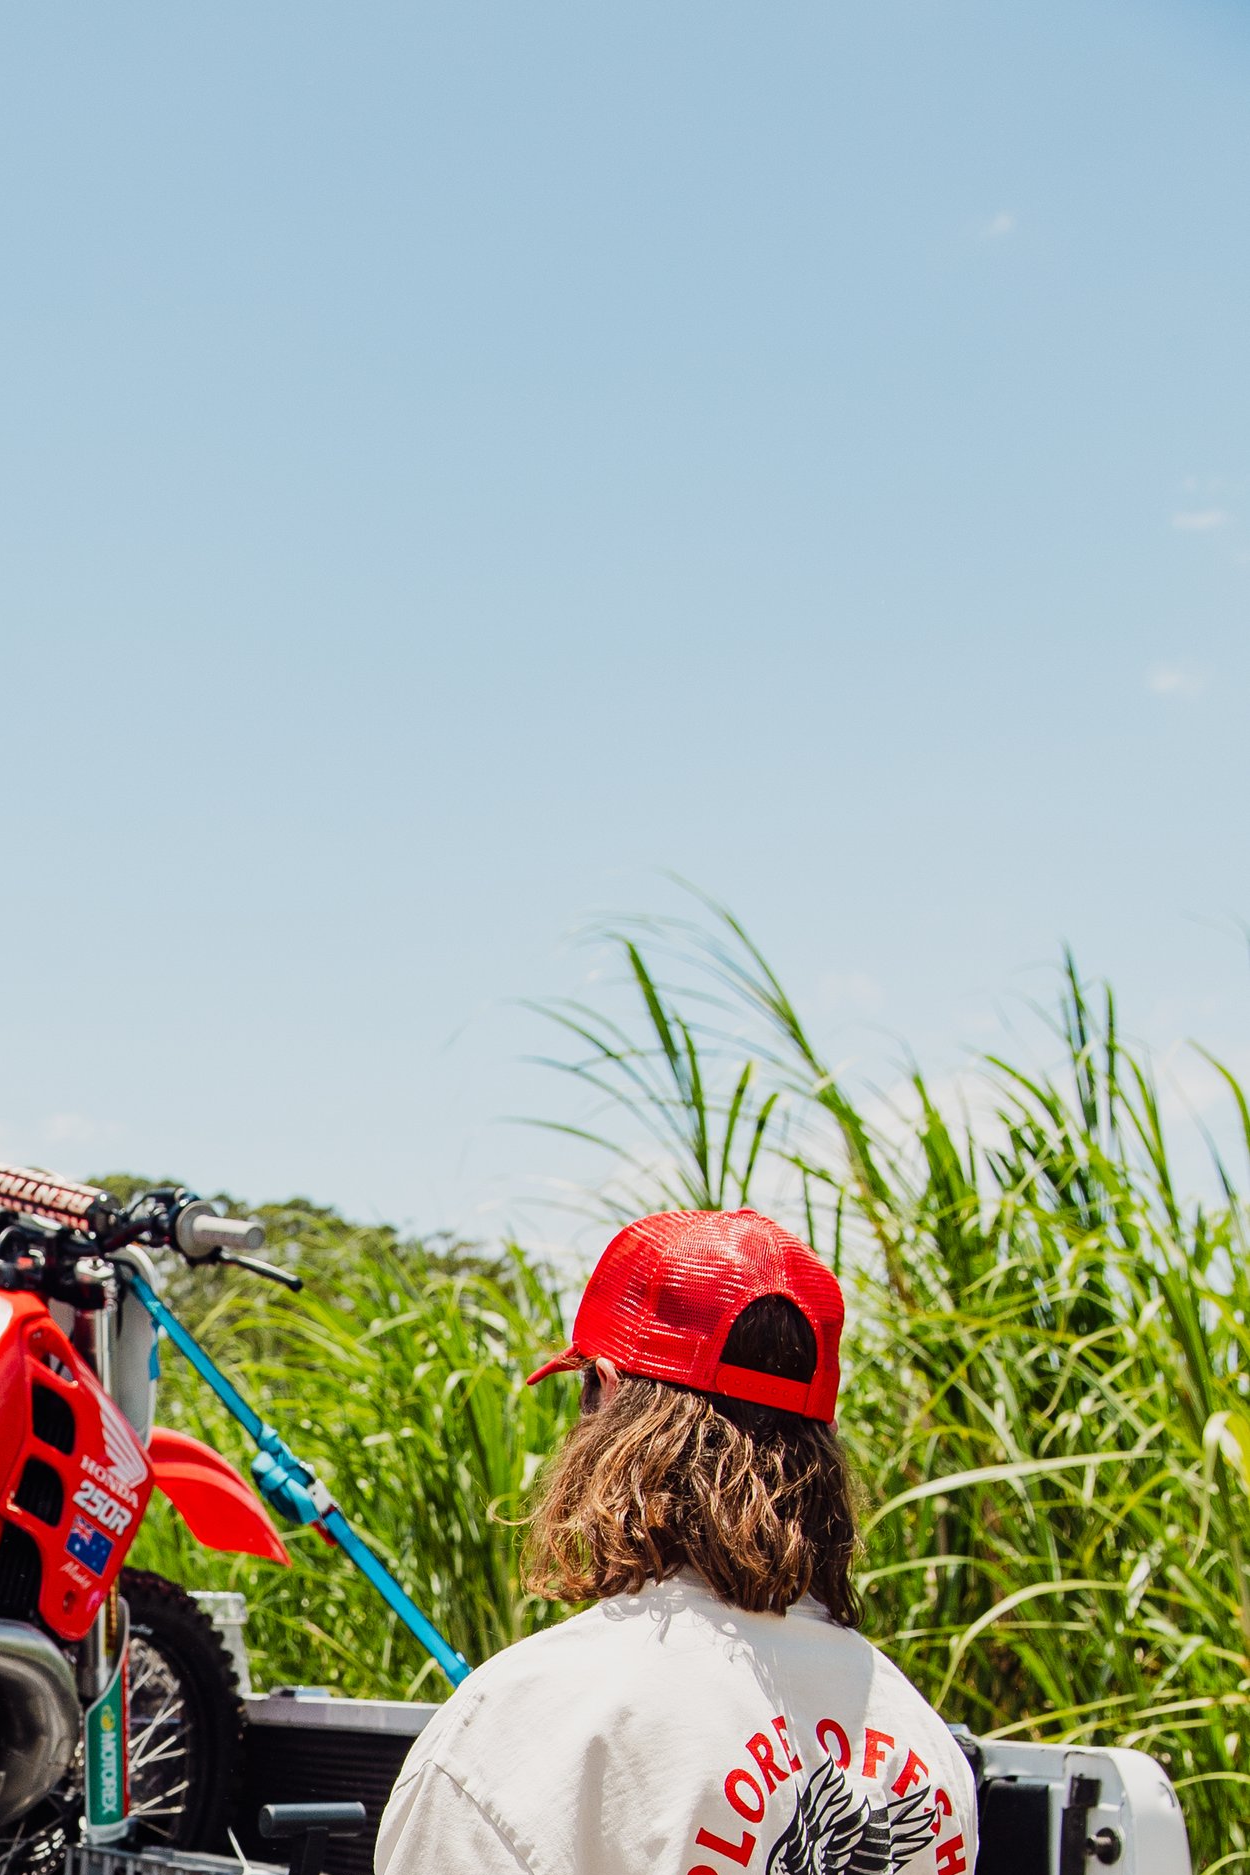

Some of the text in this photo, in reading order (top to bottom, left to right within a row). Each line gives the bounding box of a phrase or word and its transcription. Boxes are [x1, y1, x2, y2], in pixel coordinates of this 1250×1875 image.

[71, 1479, 134, 1538] 250R
[79, 1454, 140, 1510] HONDA
[100, 1732, 118, 1815] MOTOREX
